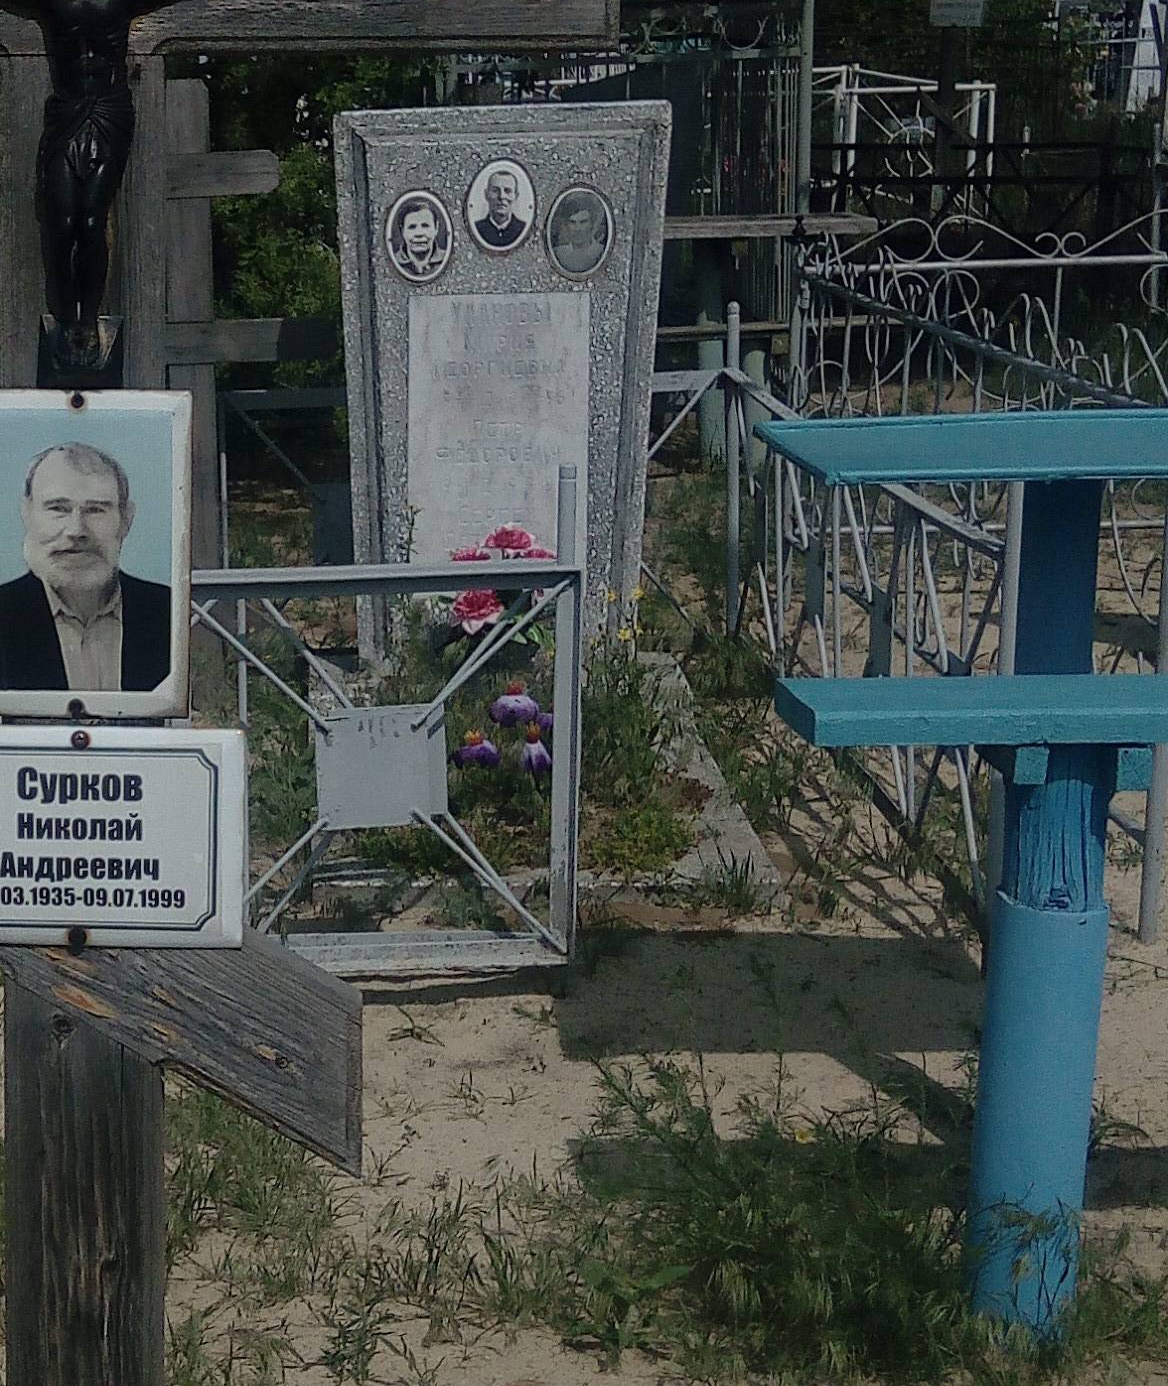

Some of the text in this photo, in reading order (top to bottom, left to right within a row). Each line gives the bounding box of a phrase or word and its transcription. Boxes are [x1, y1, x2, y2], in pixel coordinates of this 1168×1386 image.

[16, 766, 143, 804] Сурков
[16, 813, 143, 841] Николай
[0, 851, 160, 882] Андреевич
